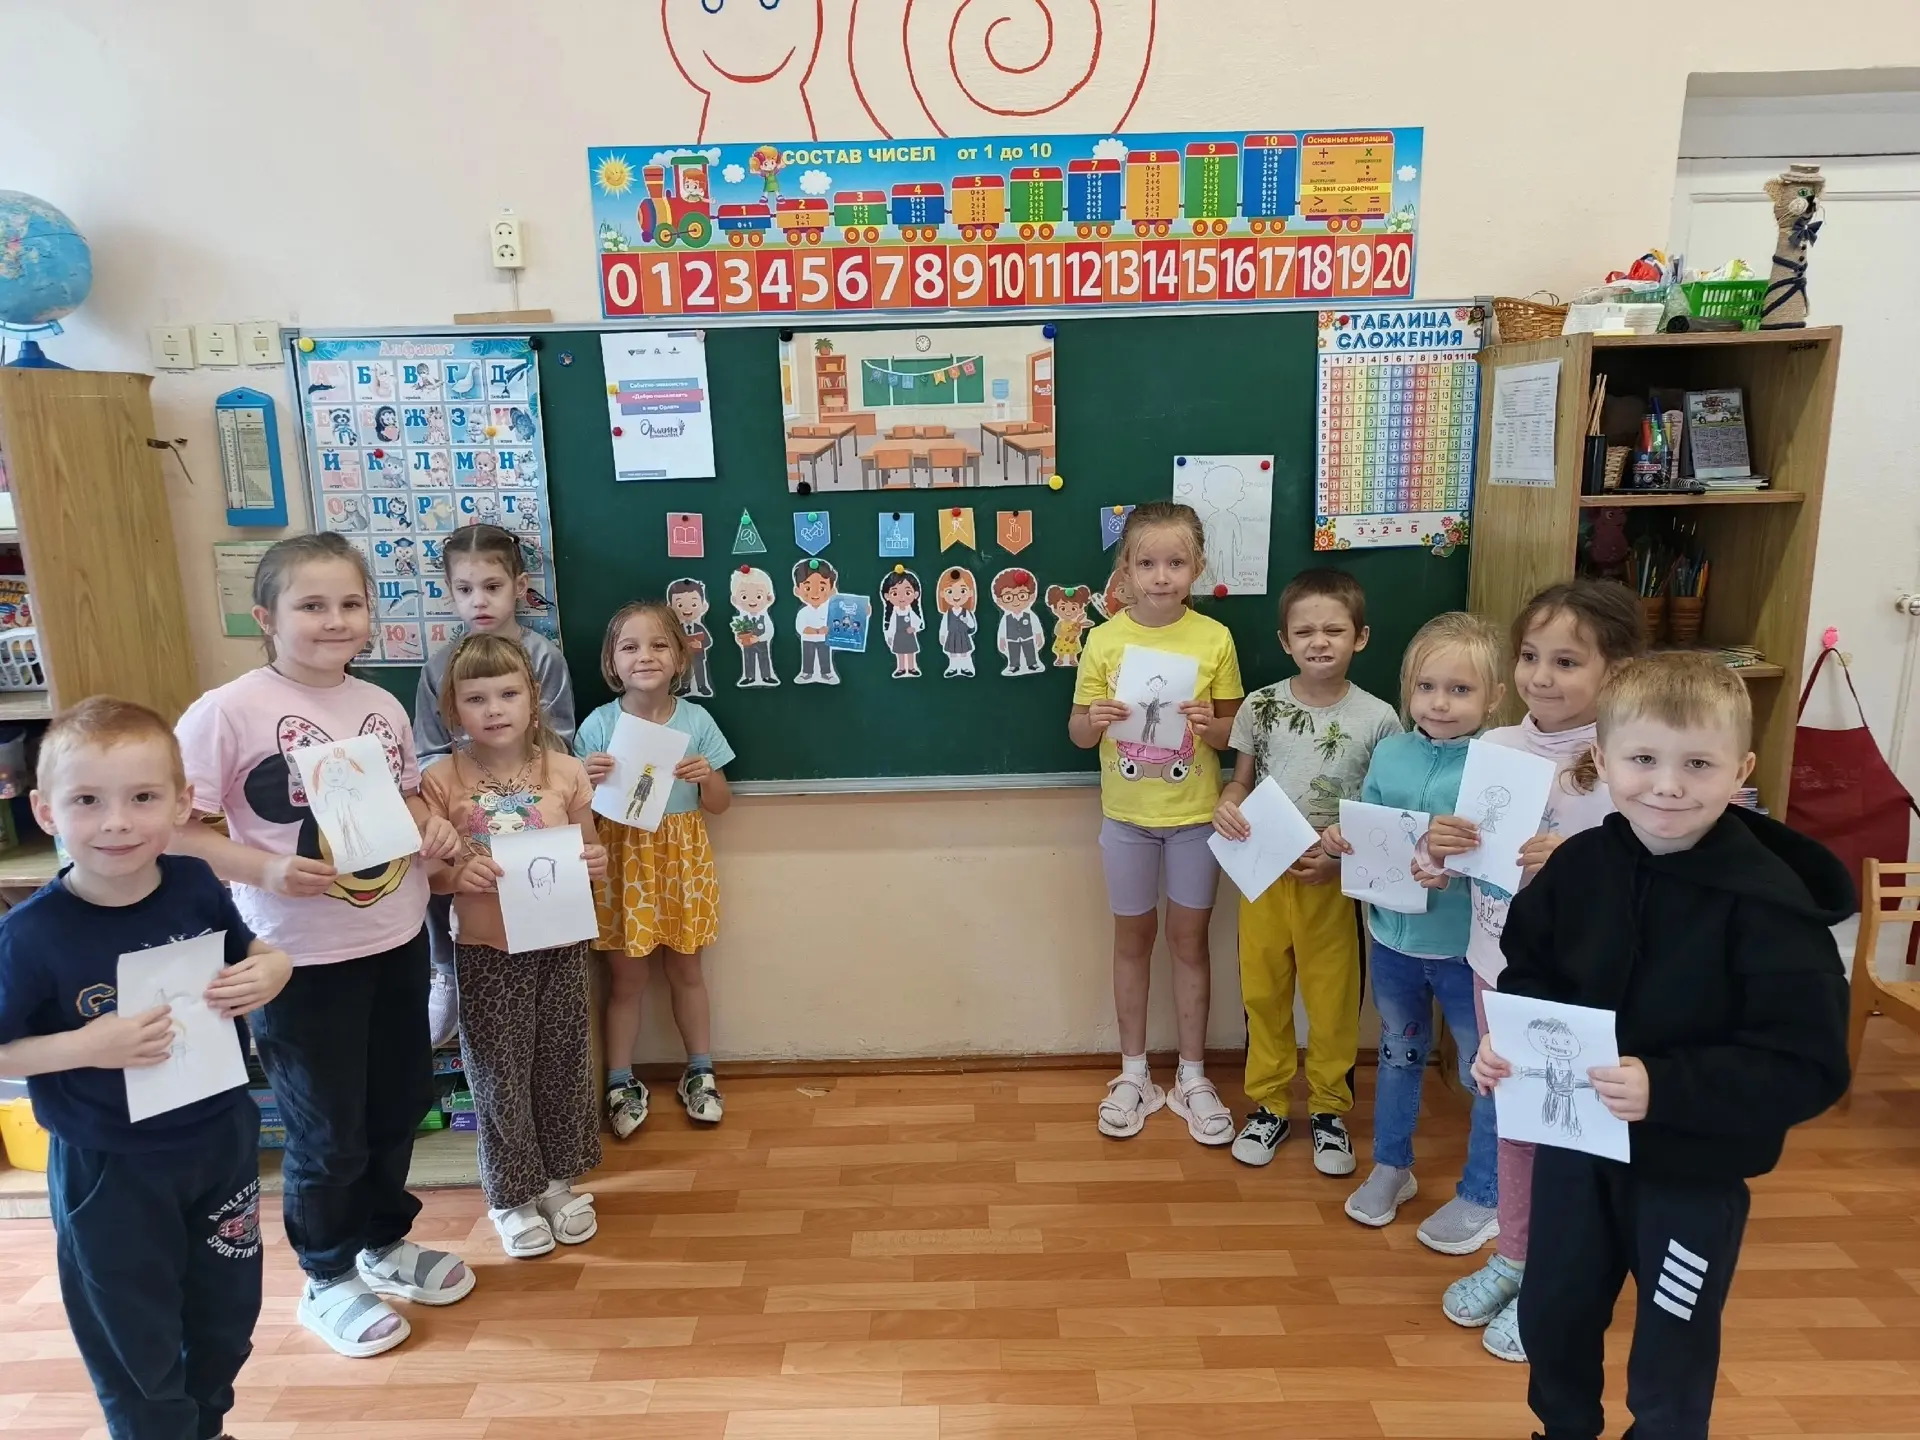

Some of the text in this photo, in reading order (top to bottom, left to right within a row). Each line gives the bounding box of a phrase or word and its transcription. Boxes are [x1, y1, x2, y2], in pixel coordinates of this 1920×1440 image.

[1264, 136, 1278, 145] 10
[782, 143, 1051, 164] СОСТАВ ЧИСЕЛ от 1 до 10
[1208, 144, 1215, 153] 9
[1150, 152, 1156, 161] 8
[1091, 161, 1098, 170] 7
[1033, 169, 1040, 178] 6
[975, 177, 981, 186] 5
[914, 185, 921, 194] 4
[857, 192, 863, 201] 3
[740, 206, 746, 215] 1
[799, 200, 805, 209] 2
[608, 243, 1410, 307] 0 1 2 3 4 5 6 7 8 9 10 11 12 13 14 15 16 17 18 19 20
[1350, 312, 1452, 330] ТАБЛИЦА
[1336, 330, 1462, 350] СЛОЖЕНИЯ
[357, 366, 371, 384] Б
[403, 366, 417, 383] В
[447, 366, 458, 383] Г
[491, 365, 506, 385] Д
[316, 405, 510, 427] Е Ё Ж З И
[323, 449, 341, 470] Й
[414, 452, 430, 469] Л
[456, 452, 474, 469] М
[499, 452, 514, 469] Н
[328, 496, 516, 515] О П Р С Т
[1358, 527, 1364, 535] 3
[1411, 525, 1417, 533] 5
[375, 540, 438, 557] Ф Х
[425, 581, 442, 598] Ъ
[386, 624, 445, 641] Ю Я
